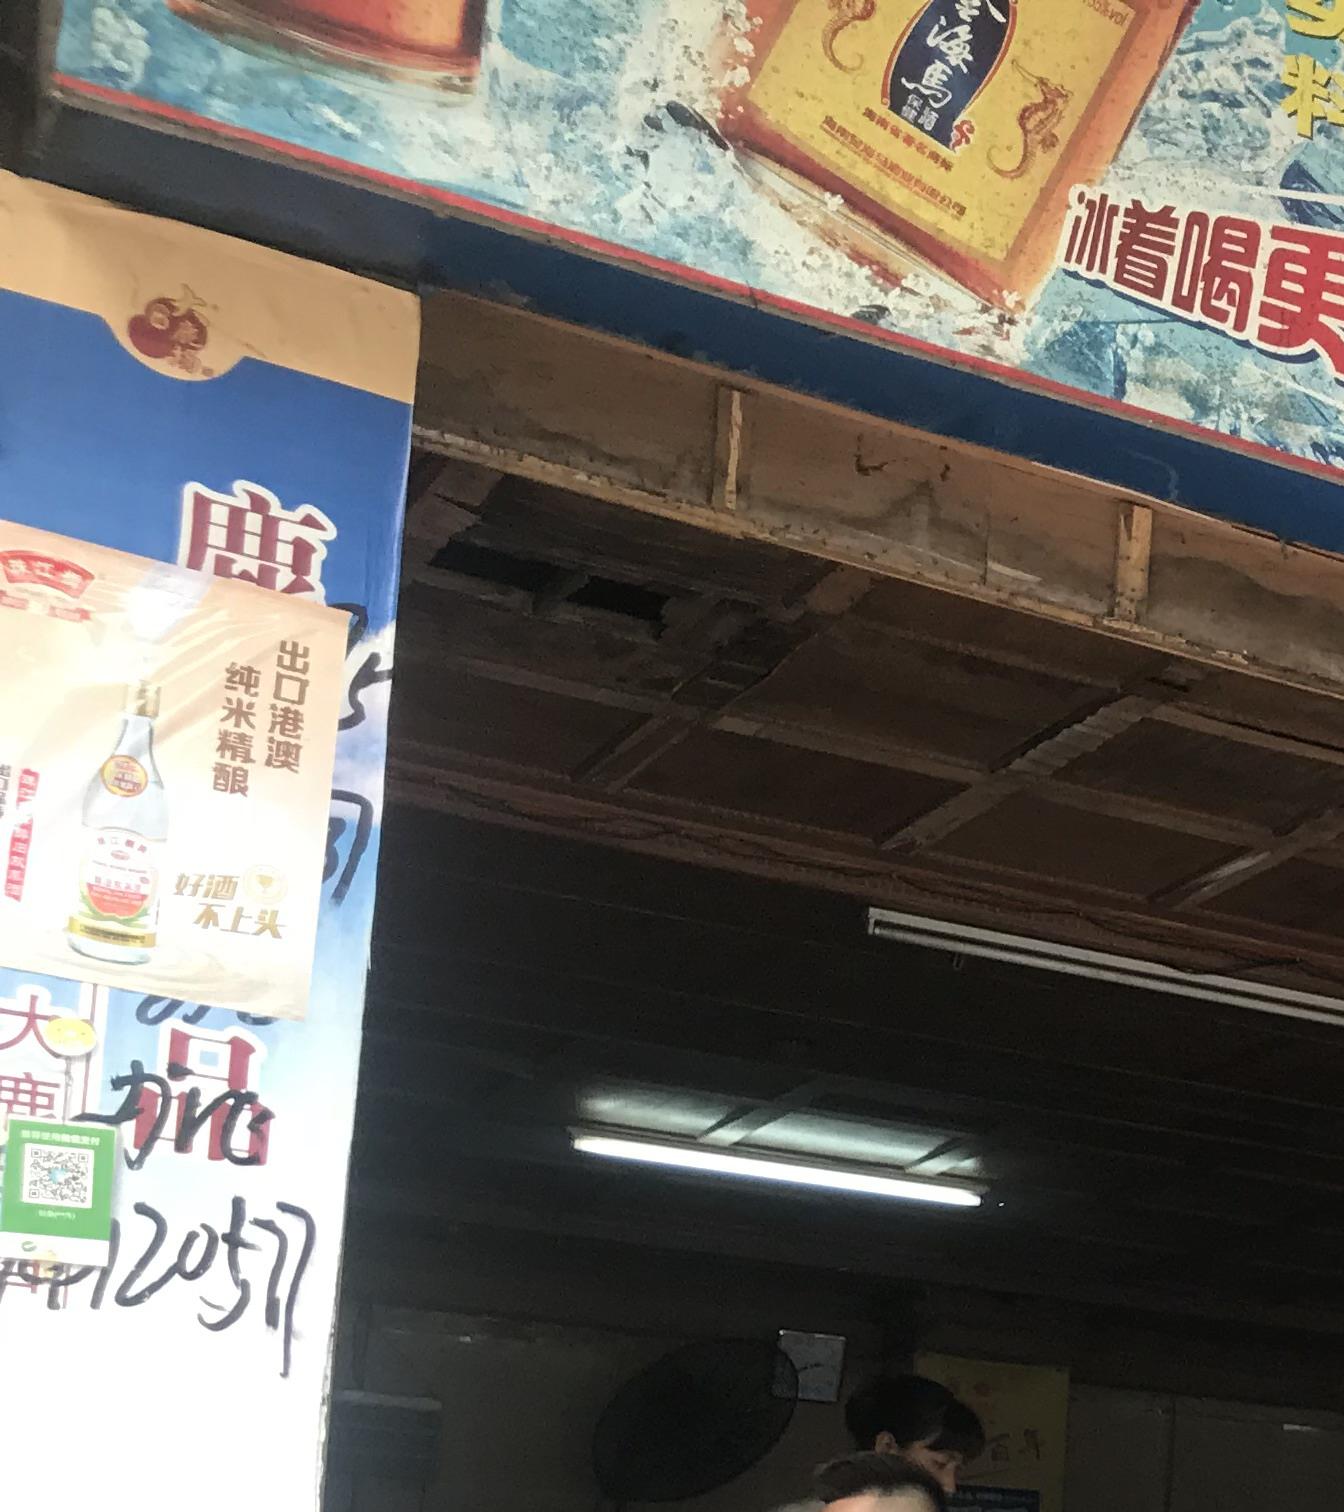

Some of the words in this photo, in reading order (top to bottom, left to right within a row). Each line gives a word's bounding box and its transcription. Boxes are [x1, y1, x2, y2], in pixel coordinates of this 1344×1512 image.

[212, 662, 262, 798] 纯米精酿
[268, 640, 310, 774] 出口港澳
[174, 872, 241, 901] 好酒
[193, 902, 287, 940] 不上头
[132, 1028, 276, 1167] 品
